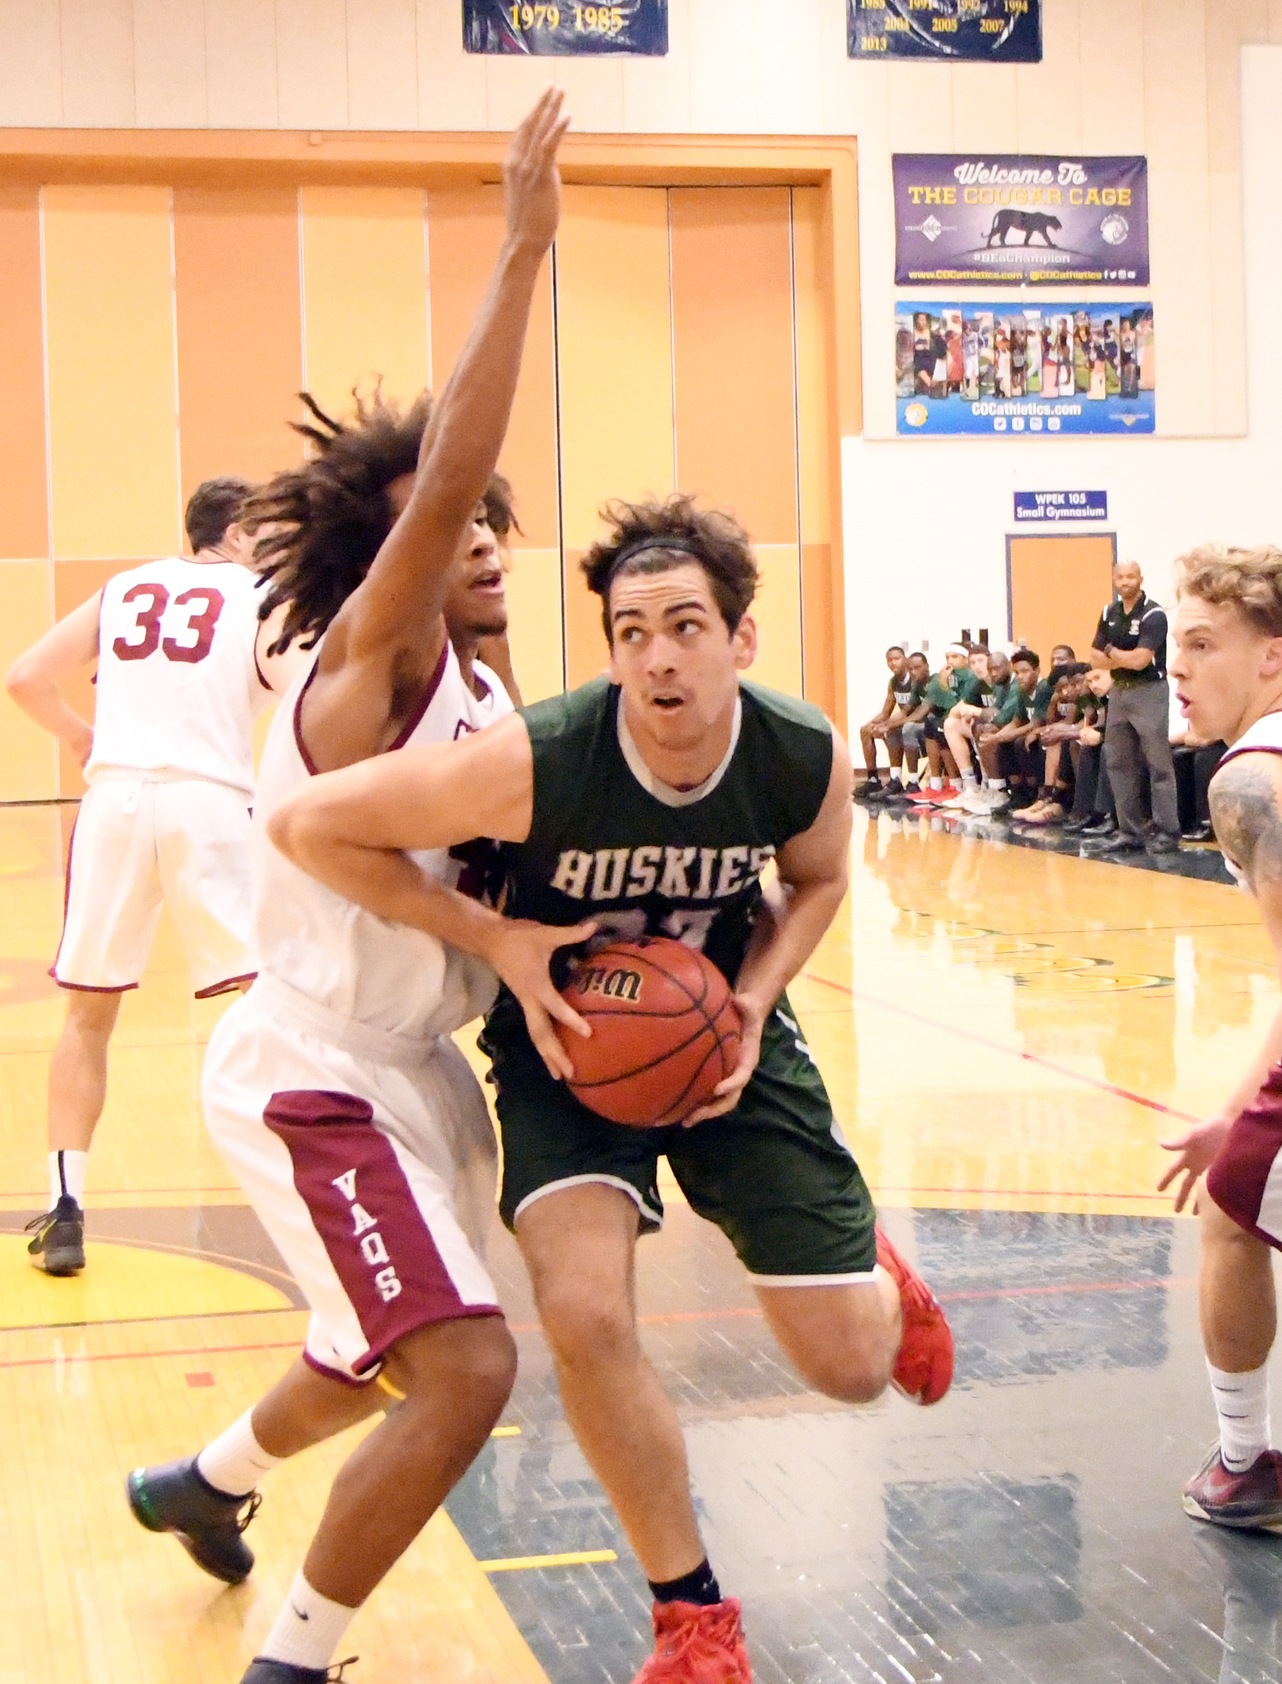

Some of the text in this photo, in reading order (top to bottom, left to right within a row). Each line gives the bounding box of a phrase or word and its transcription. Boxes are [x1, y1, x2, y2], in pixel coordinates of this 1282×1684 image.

[509, 5, 623, 32] 1979 1985
[954, 162, 1088, 186] Welcome To
[908, 186, 1132, 206] THE COUGAR CAGE
[971, 402, 1082, 416] COCathletics.com
[1035, 493, 1087, 505] WPEK 105
[1016, 505, 1105, 520] Small Gymnasium
[112, 582, 226, 664] 33
[550, 844, 777, 900] HUSKIES
